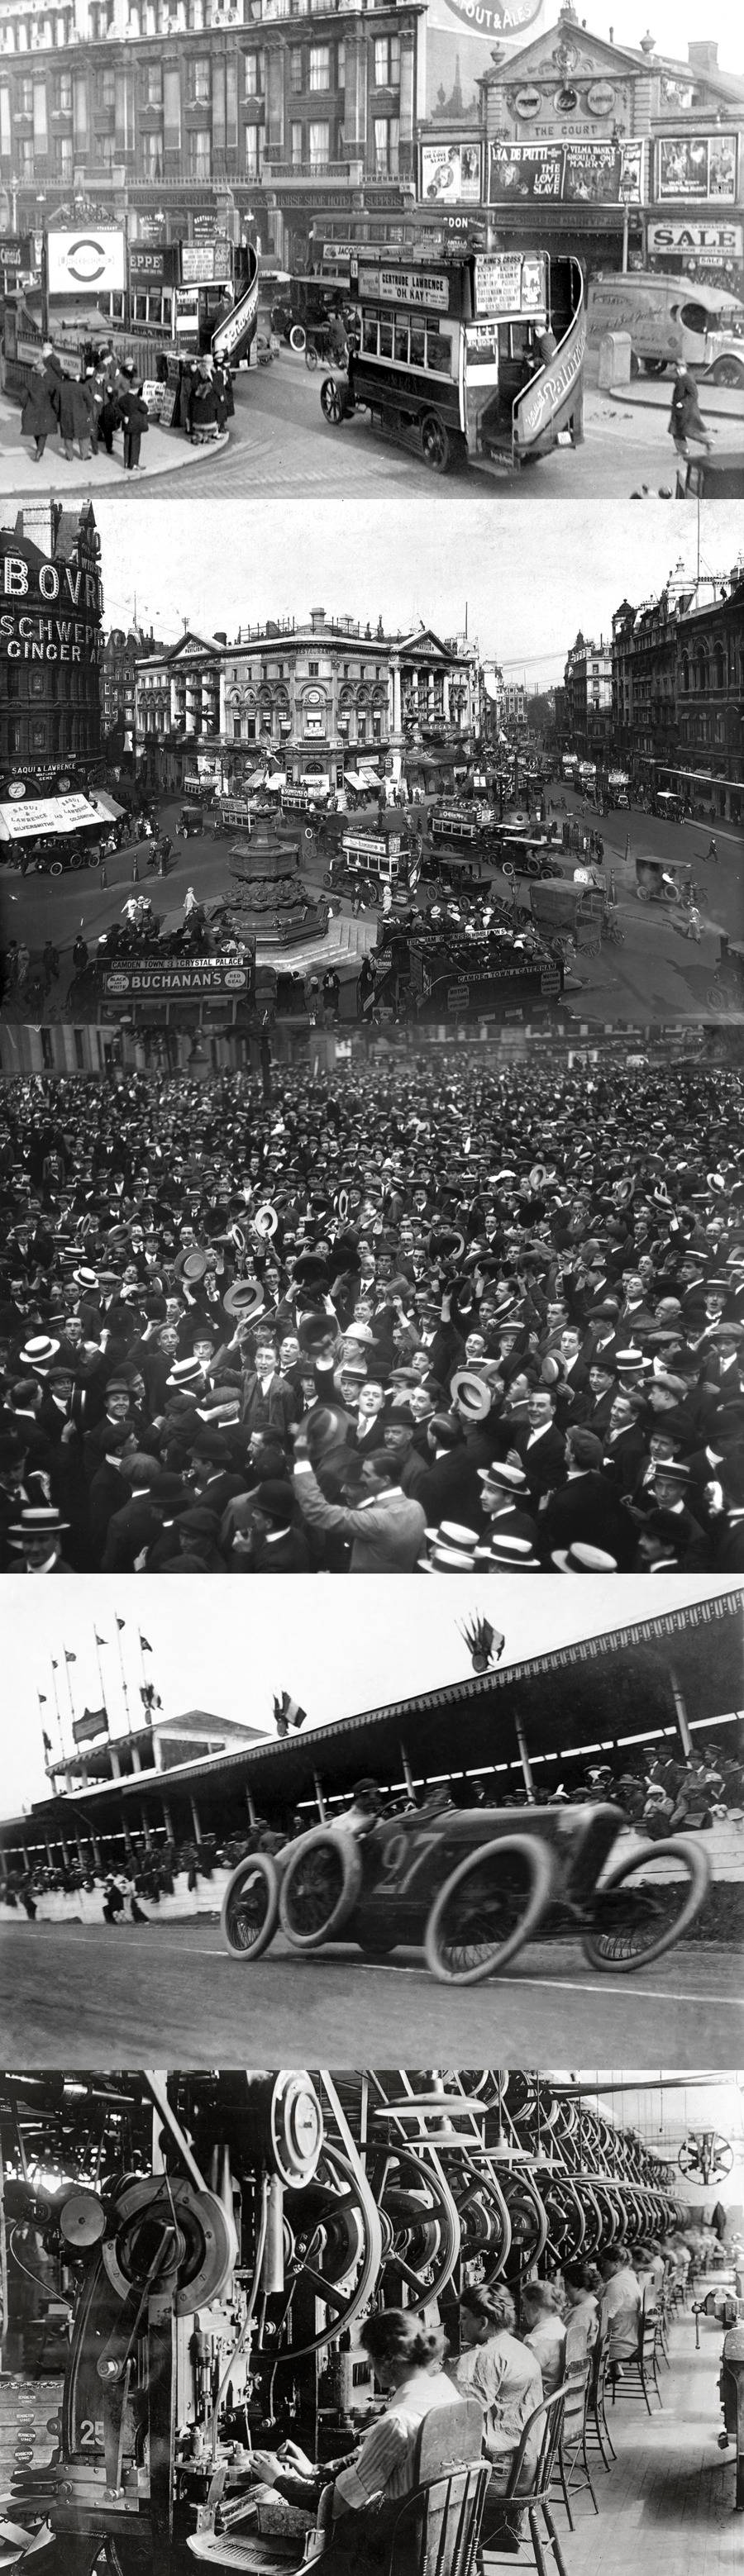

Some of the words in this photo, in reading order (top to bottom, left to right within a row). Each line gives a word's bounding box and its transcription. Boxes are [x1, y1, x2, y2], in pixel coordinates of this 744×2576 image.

[536, 127, 554, 136] THE
[561, 126, 597, 135] COURT
[510, 148, 521, 160] DE
[523, 147, 547, 160] PUTTI
[570, 146, 591, 155] VILMA
[594, 146, 615, 155] BANKY
[541, 164, 560, 173] THE
[535, 174, 560, 183] LOVE
[533, 185, 560, 194] SLAVE
[278, 193, 303, 206] HORSE
[304, 193, 326, 206] SHOE
[327, 193, 352, 206] HOTEL
[365, 193, 402, 206] SUPPERS
[654, 230, 736, 247] SALE
[382, 274, 408, 287] GERTRUDE
[413, 278, 443, 291] LAWRENCE
[7, 640, 81, 661] GINGER
[12, 766, 36, 774] SAQUI
[43, 763, 76, 772] LAWRENCE
[62, 798, 80, 806] SAQUI
[13, 805, 38, 813] SAQUI
[64, 804, 88, 814] LAWRENCE
[11, 812, 48, 821] LAWRENCE
[13, 821, 55, 831] SILVERSMITHS
[470, 929, 500, 938] WIMBLEON
[179, 959, 212, 967] CRYSTAL
[215, 957, 242, 966] PALACE
[131, 972, 222, 989] BUCHANAN'S
